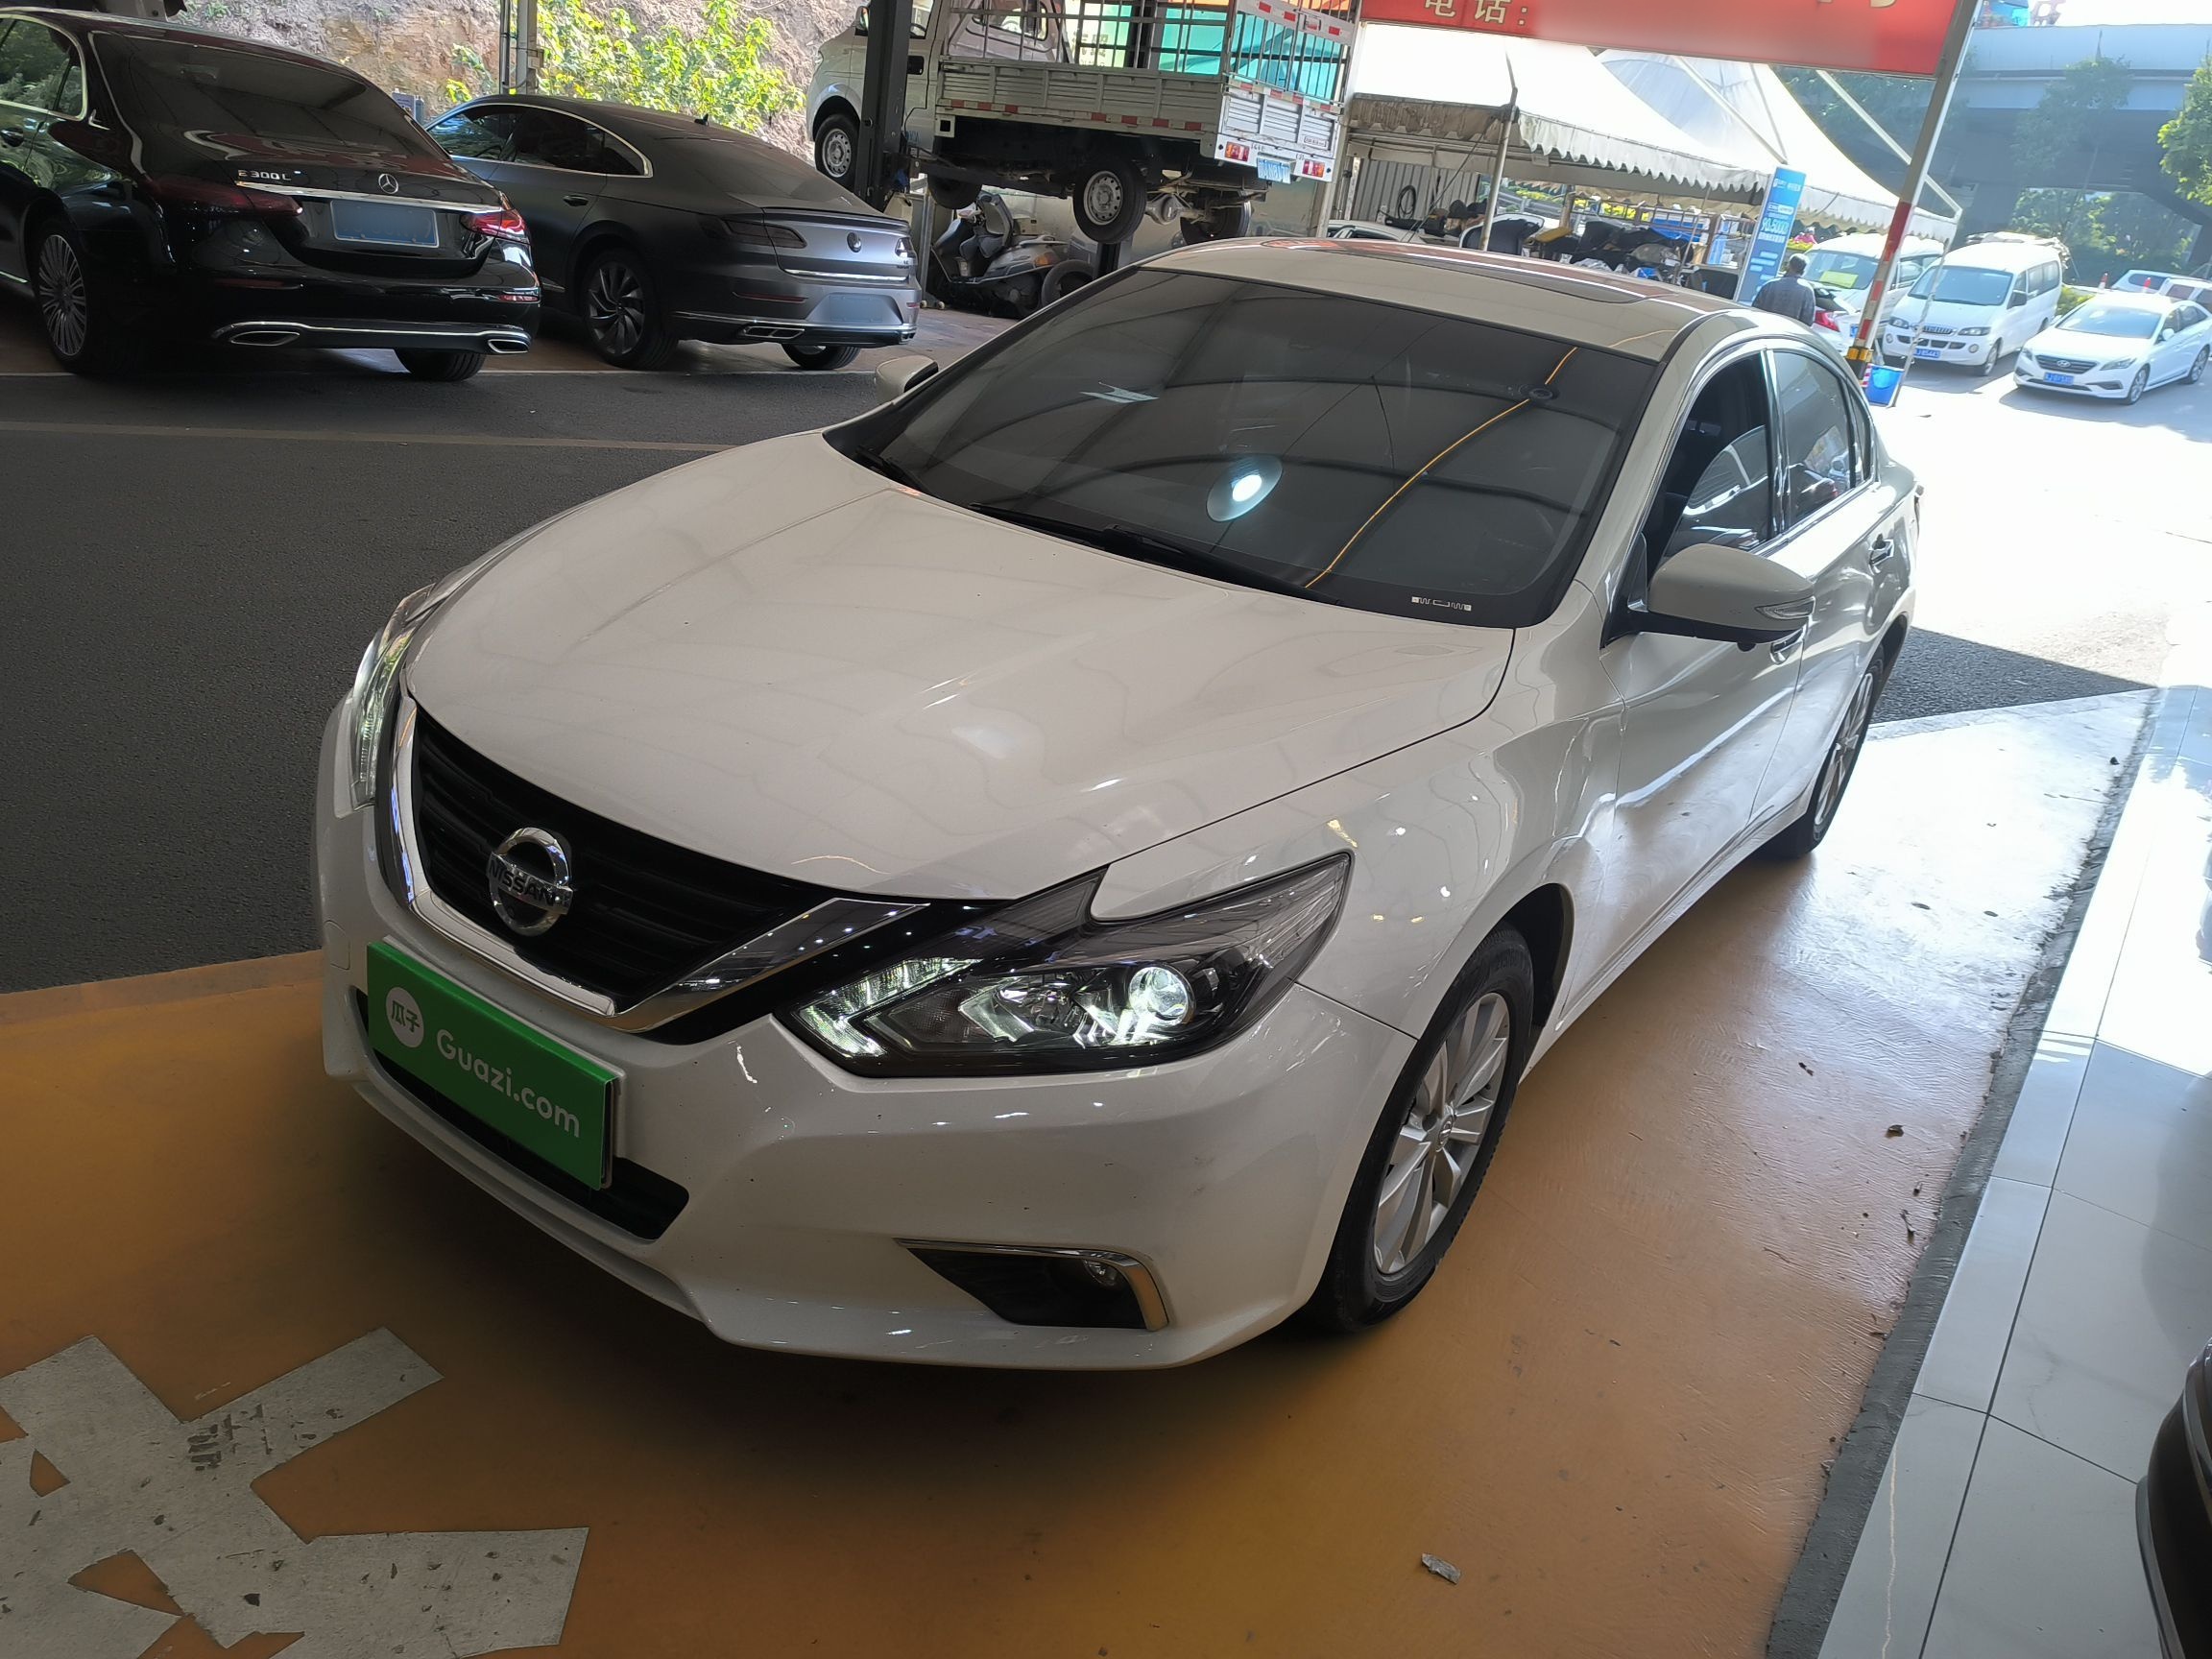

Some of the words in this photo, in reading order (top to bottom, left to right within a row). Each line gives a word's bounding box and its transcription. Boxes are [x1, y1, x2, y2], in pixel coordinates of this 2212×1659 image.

[489, 859, 556, 908] NISSAN
[391, 999, 421, 1033] 瓜子
[437, 1029, 580, 1138] Guazi.com
